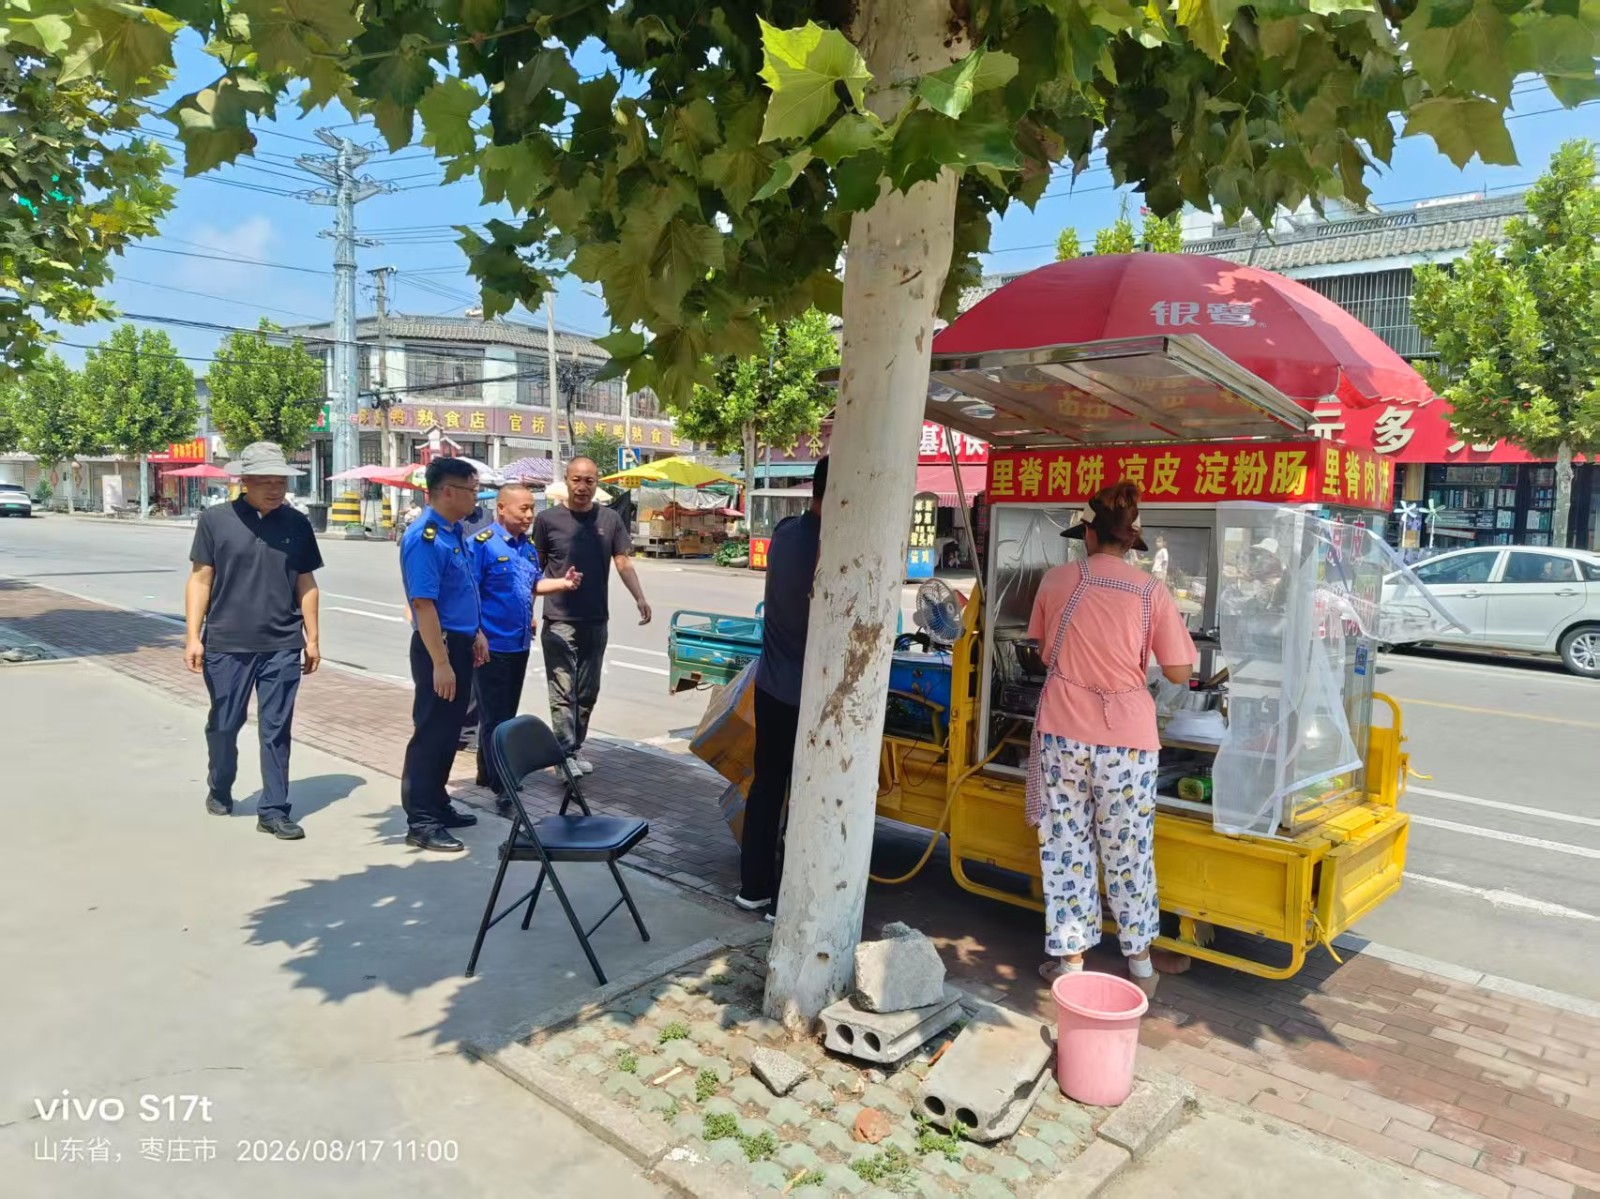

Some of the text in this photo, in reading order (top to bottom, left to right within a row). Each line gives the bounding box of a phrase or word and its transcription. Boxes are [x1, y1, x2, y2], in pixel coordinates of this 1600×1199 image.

[1149, 300, 1257, 327] 银鹭
[989, 450, 1308, 496] 里脊肉饼 凉皮 淀粉肠
[1322, 448, 1390, 504] 里脊肉饼
